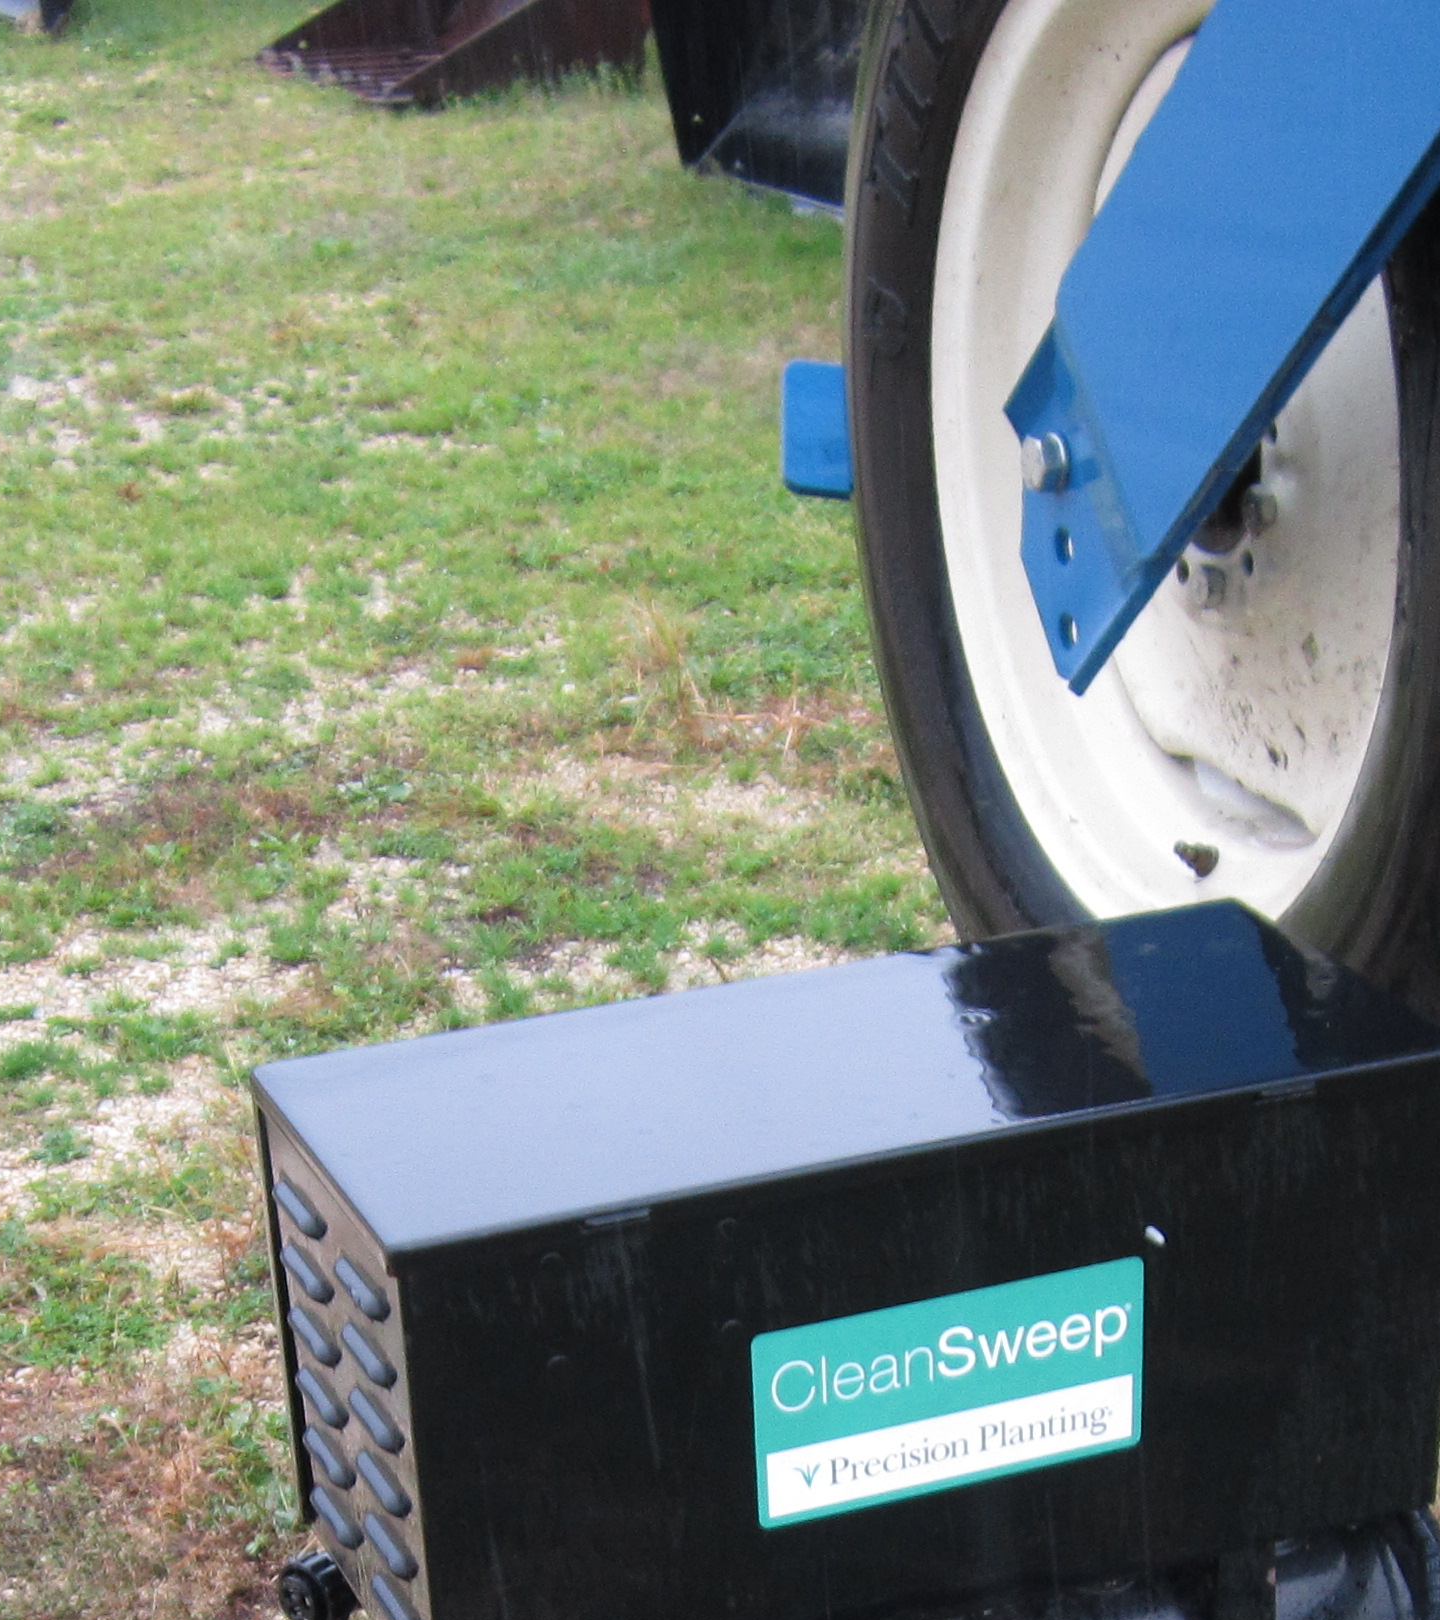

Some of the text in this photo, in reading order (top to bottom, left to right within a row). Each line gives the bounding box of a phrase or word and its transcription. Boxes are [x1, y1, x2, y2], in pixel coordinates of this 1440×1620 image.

[771, 1304, 1128, 1412] CleanSweep
[829, 1407, 1108, 1485] Precision Planting
